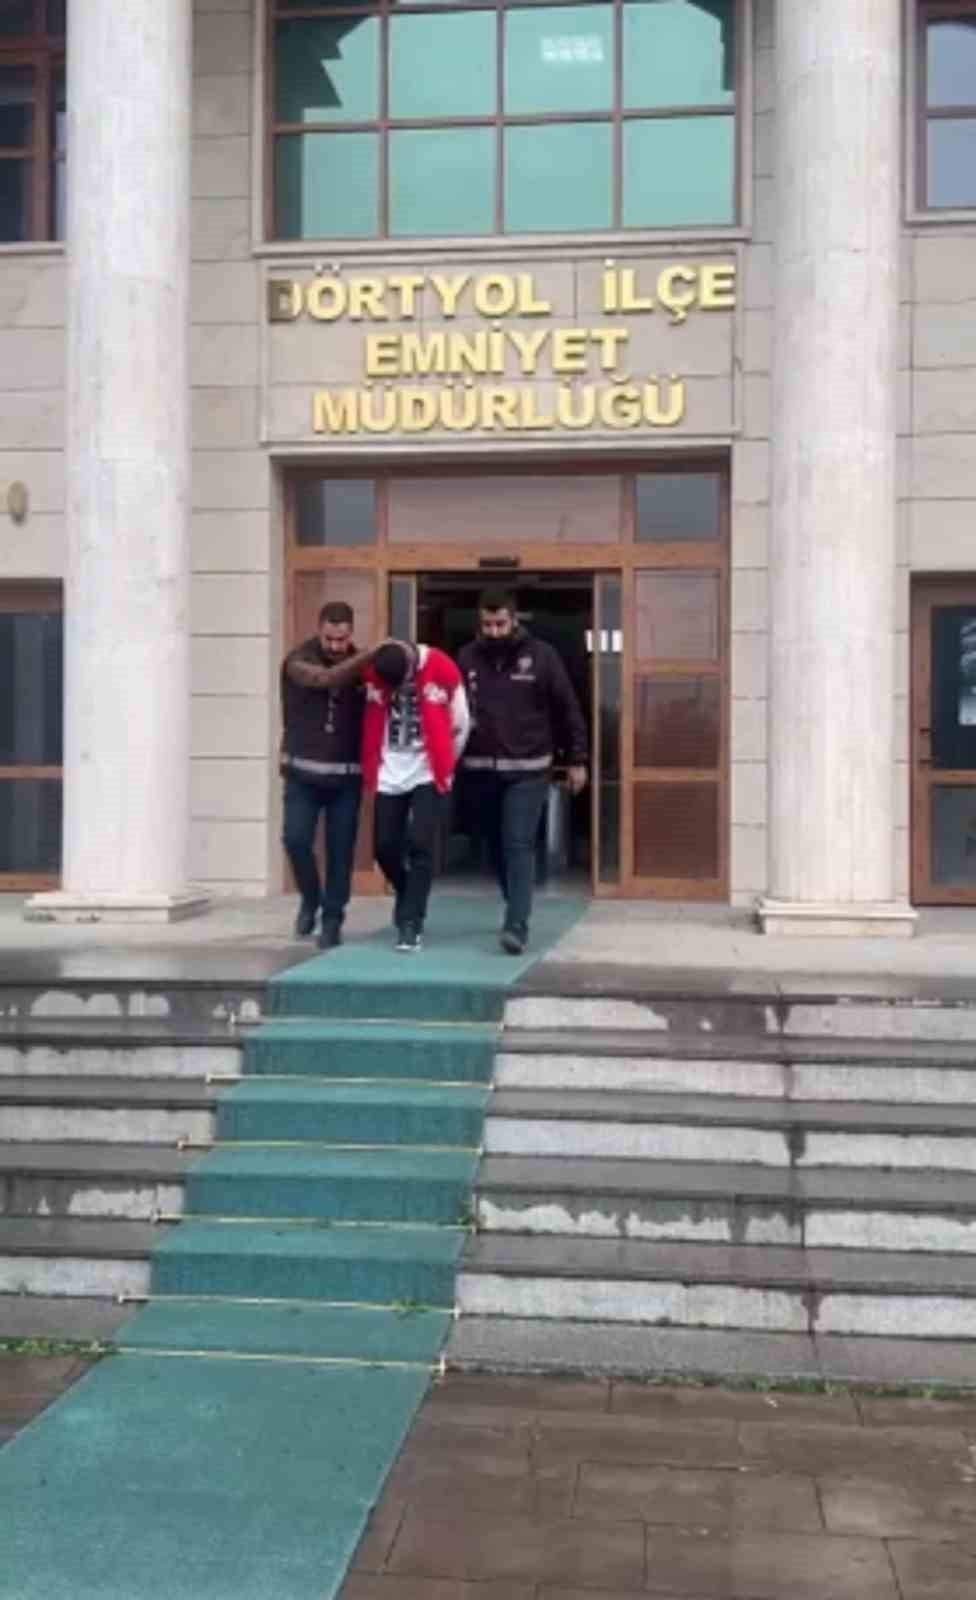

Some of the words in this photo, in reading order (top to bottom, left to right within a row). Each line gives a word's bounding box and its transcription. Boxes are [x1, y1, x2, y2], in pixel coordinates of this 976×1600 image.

[268, 263, 550, 322] DÖRTYOL
[603, 258, 735, 324] İLÇE
[366, 322, 627, 377] EMNİYET
[313, 372, 684, 432] MÜDÜRLÜĞÜ
